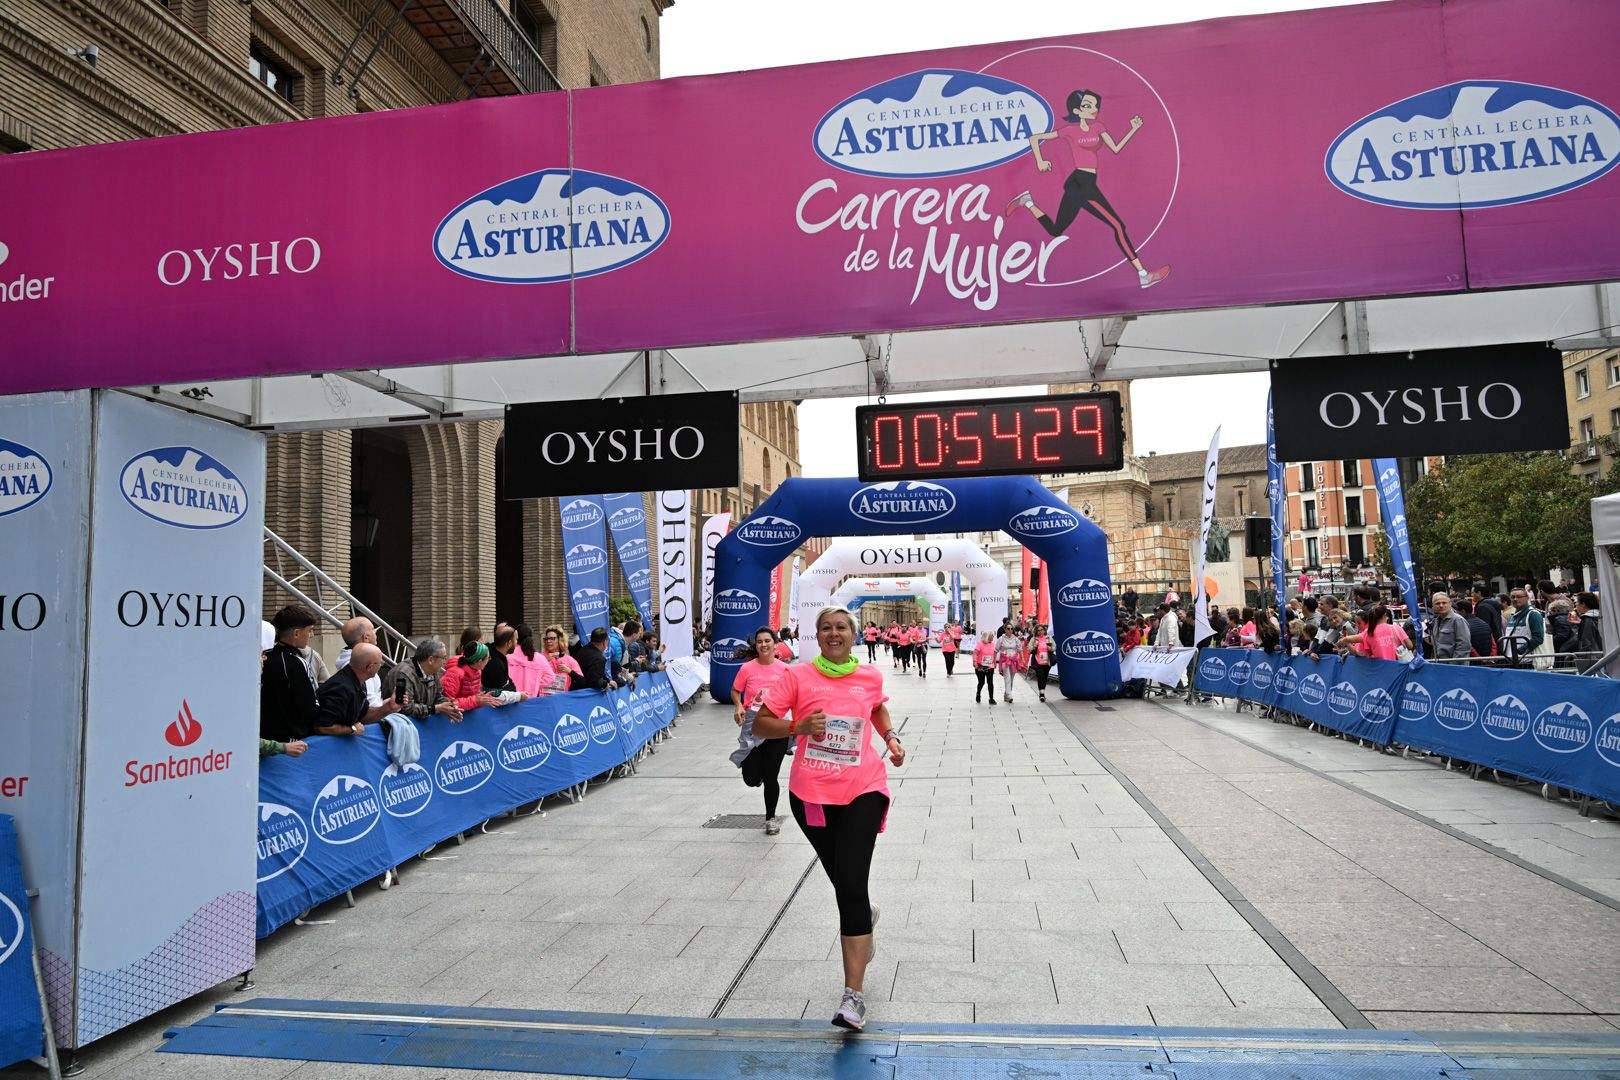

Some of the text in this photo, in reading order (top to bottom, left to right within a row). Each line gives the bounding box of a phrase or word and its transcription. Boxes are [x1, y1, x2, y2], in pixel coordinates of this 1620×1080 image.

[867, 98, 1026, 122] CENTRAL LECHERA
[832, 113, 1034, 156] ASTURIANA
[1392, 114, 1593, 144] CENTRAL LECHERA
[1349, 131, 1607, 184] ASTURIANA
[487, 200, 643, 224] CENTRAL LECHERA
[795, 178, 991, 233] Carrera
[450, 216, 653, 260] ASTURIANA
[157, 237, 321, 285] OYSHO
[843, 215, 1069, 311] de la Mujer
[1319, 382, 1521, 428] OYSHO
[541, 426, 705, 465] OYSHO
[130, 467, 240, 515] ASTURIANA
[152, 469, 237, 492] CENTRAL LECHERA
[857, 494, 948, 514] ASTURIANA
[740, 526, 796, 539] ASTURIANA
[1015, 518, 1074, 531] ASTURIANA
[860, 546, 942, 565] OYSHO
[117, 590, 246, 628] OYSHO
[1061, 591, 1109, 602] ASTURIANA
[1065, 642, 1113, 654] ASTURIANA
[1437, 701, 1474, 722] ASTURIANA
[1484, 709, 1525, 732] ASTURIANA
[1536, 716, 1586, 743] ASTURIANA
[502, 742, 548, 765] ASTURIANA
[124, 749, 233, 787] Santander
[440, 758, 491, 787] ASTURIANA
[384, 780, 430, 808] ASTURIANA
[319, 797, 378, 835] ASTURIANA
